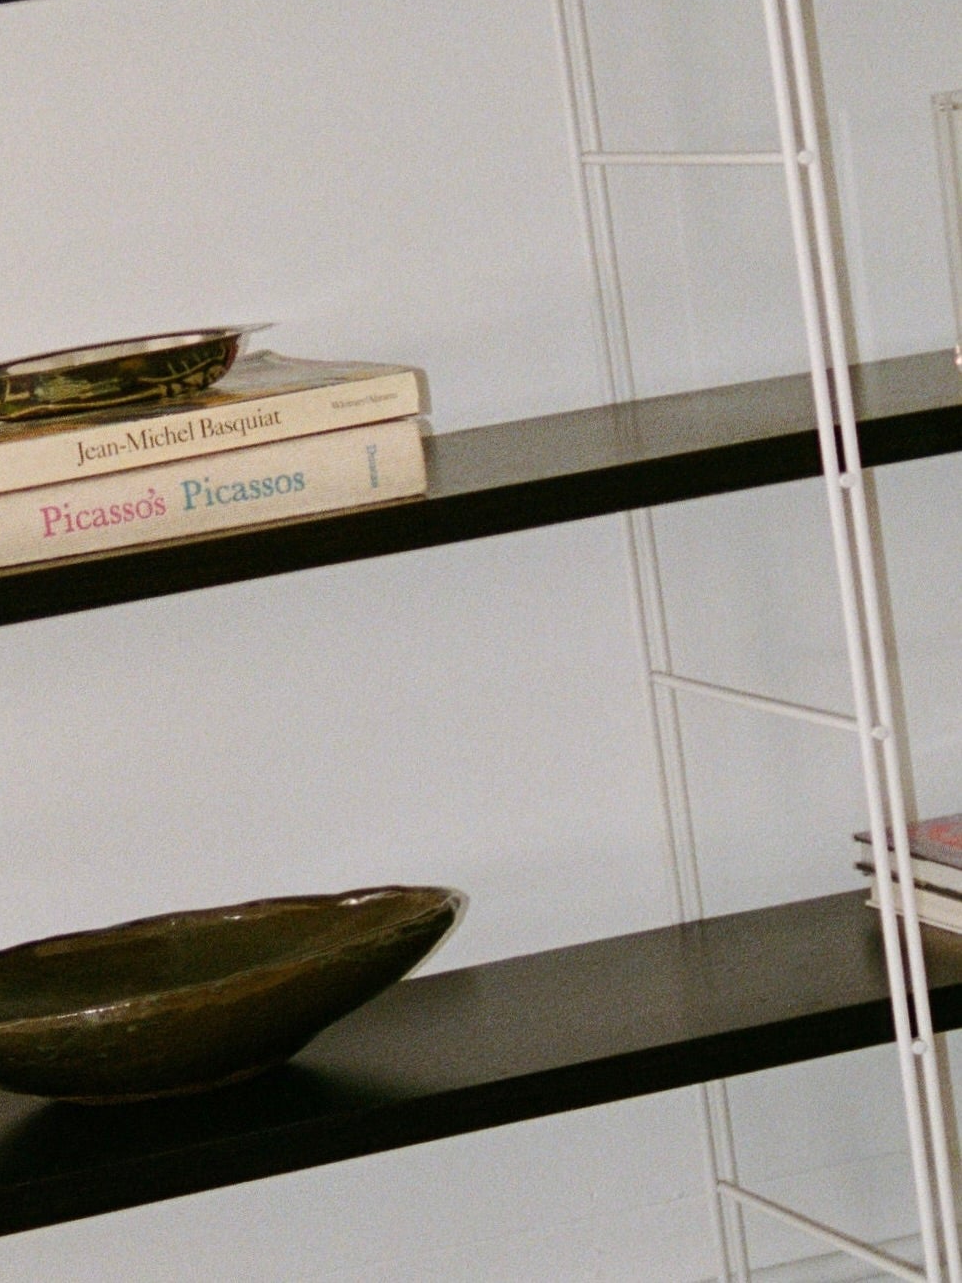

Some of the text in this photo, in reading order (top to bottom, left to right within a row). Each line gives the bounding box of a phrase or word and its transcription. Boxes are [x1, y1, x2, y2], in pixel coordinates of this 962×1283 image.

[76, 408, 283, 467] Jean-Michel Basquiat
[39, 471, 306, 539] Picasso's Picassos
